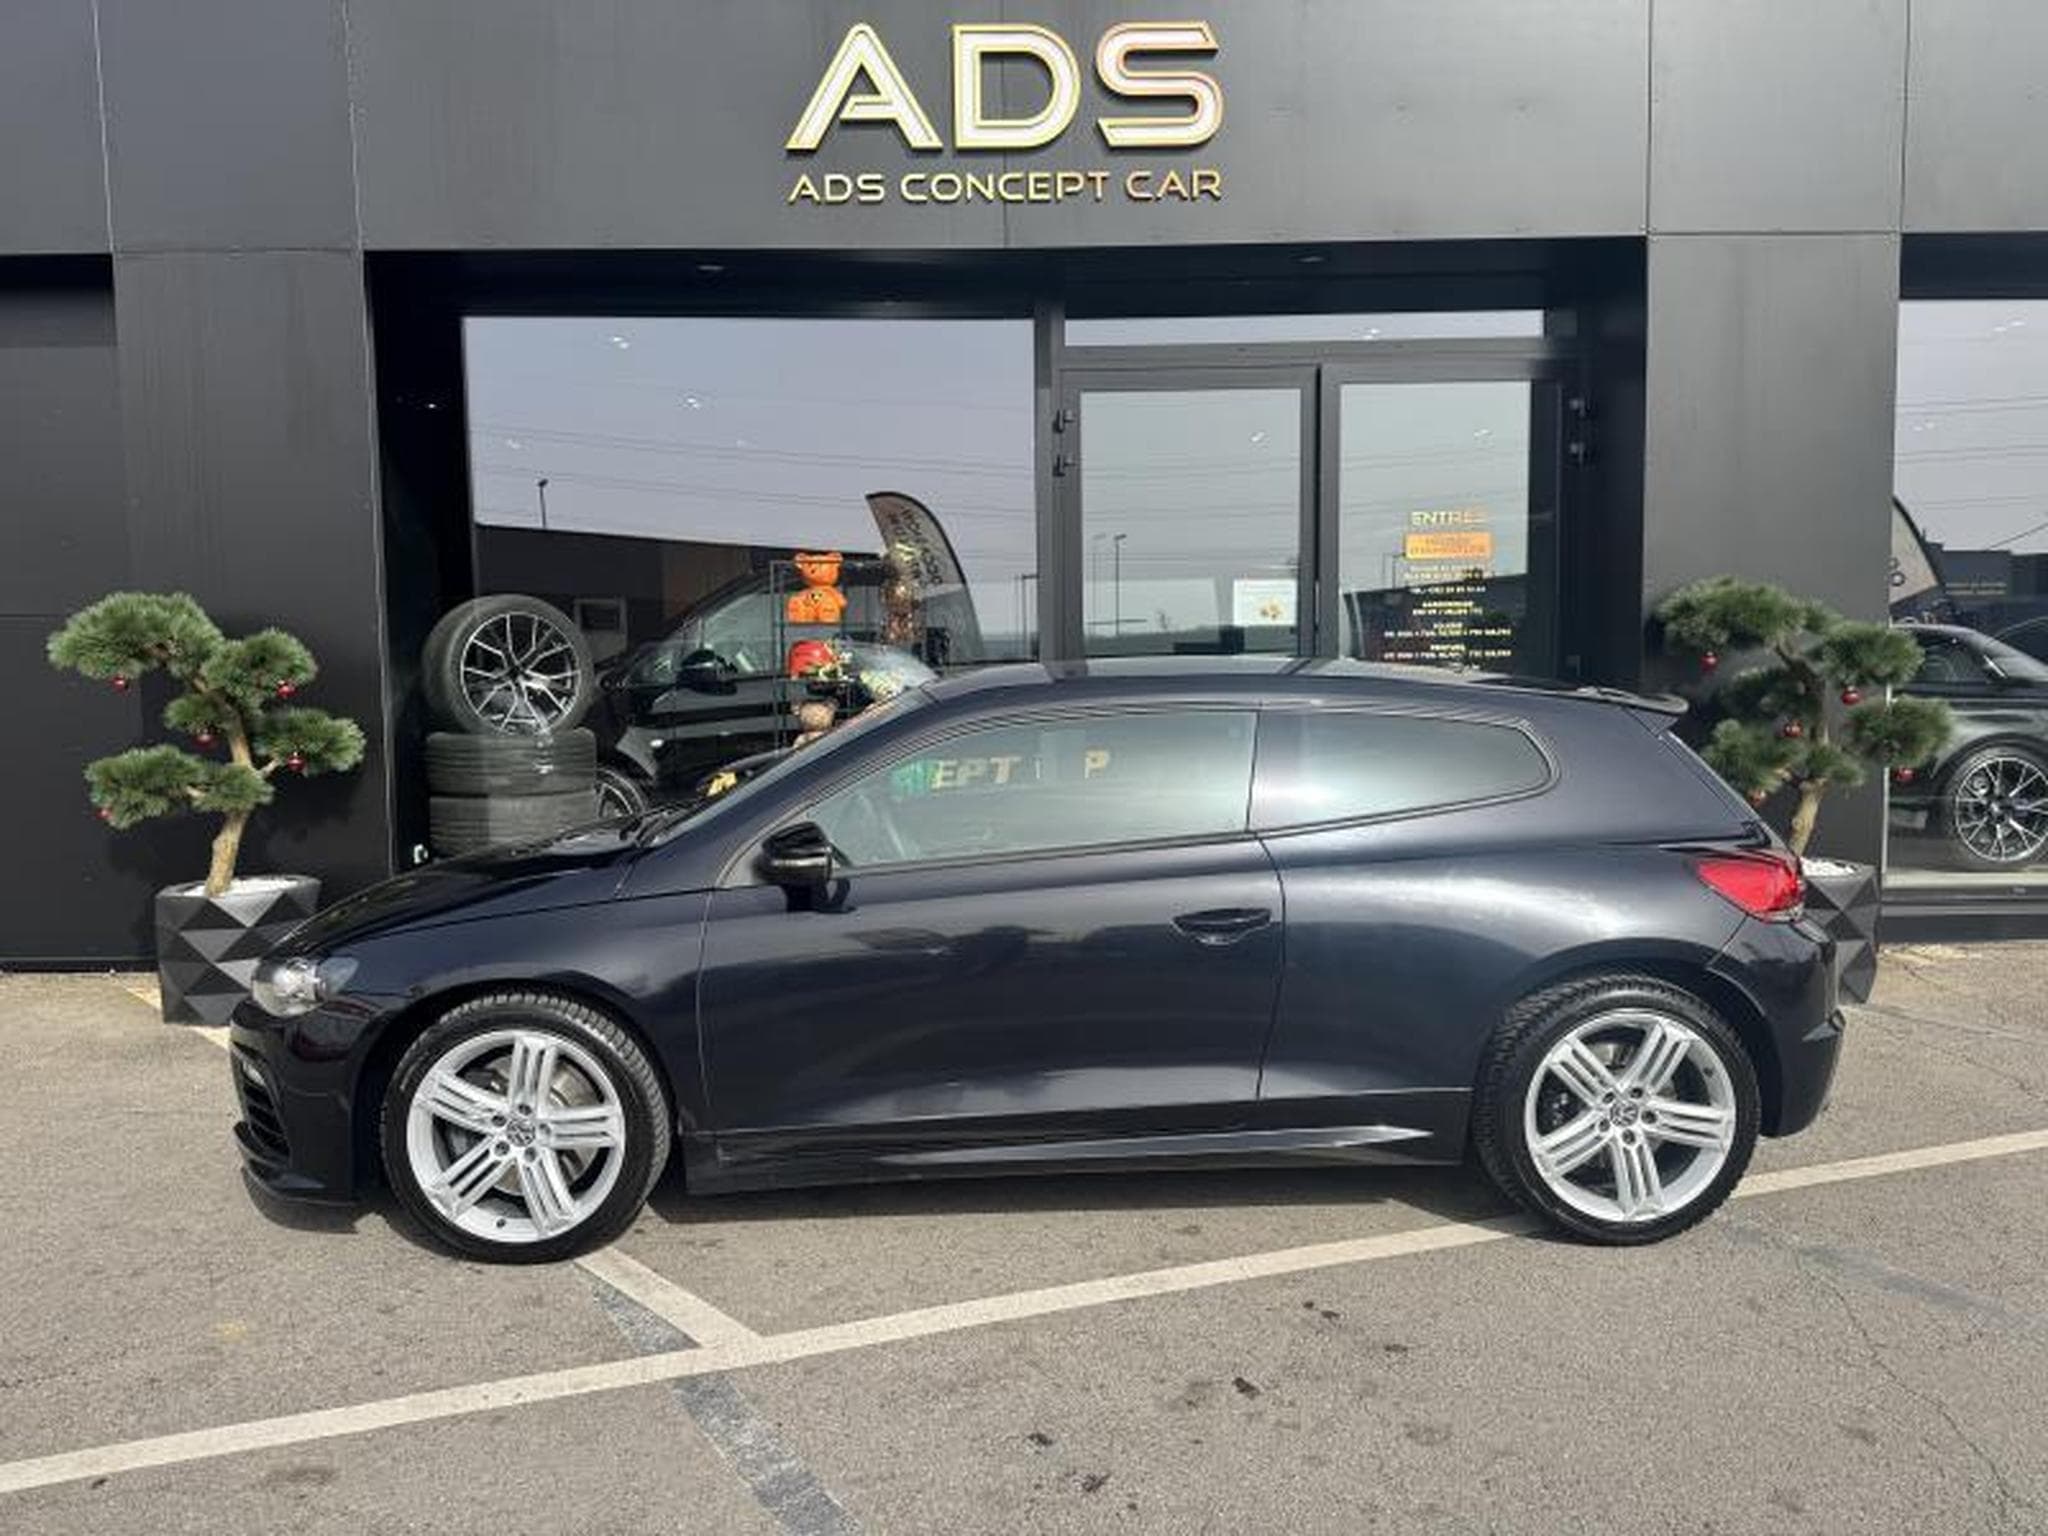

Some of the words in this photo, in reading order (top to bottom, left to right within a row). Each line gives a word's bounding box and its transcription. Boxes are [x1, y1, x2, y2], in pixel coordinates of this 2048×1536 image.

[785, 21, 1224, 151] ADS
[788, 173, 886, 203] ADS
[900, 170, 1110, 202] CONCEPT
[1125, 169, 1223, 201] CAR
